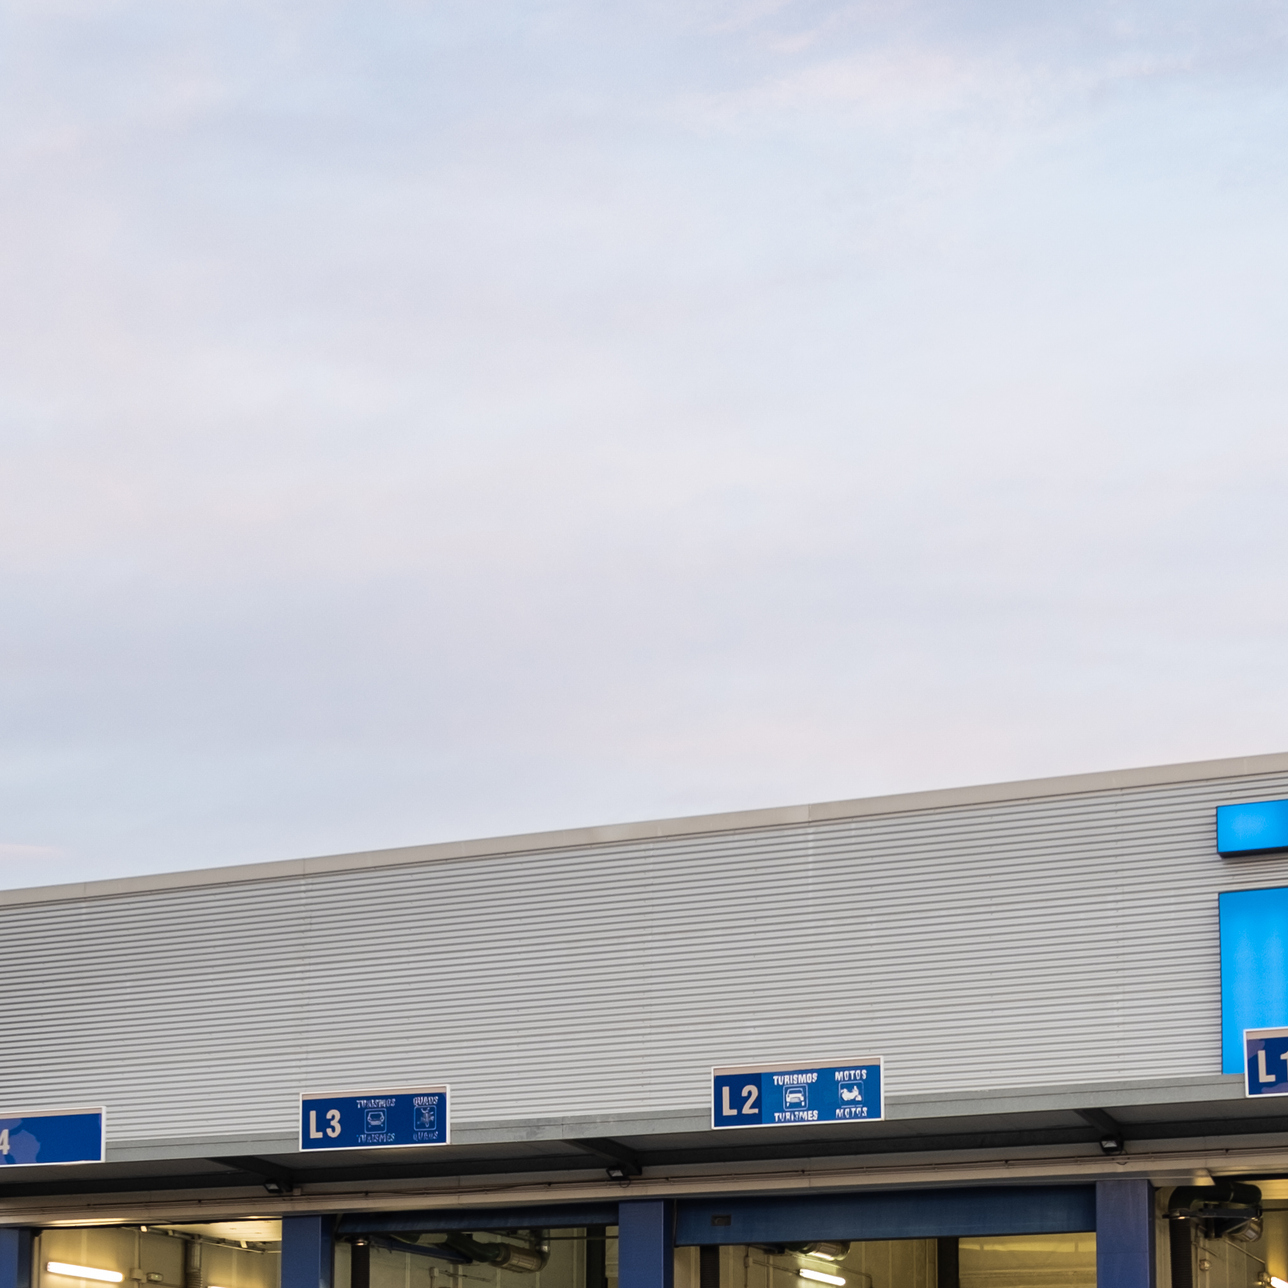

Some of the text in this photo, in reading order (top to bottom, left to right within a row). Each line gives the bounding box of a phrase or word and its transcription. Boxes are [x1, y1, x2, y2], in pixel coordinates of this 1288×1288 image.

[773, 1073, 818, 1085] TURISMOS
[835, 1069, 867, 1081] MOTOS
[356, 1098, 396, 1108] TURISMOS
[413, 1096, 439, 1107] QUADS
[722, 1084, 759, 1116] L2
[774, 1110, 818, 1122] TURISMES
[836, 1107, 868, 1118] MOTOS
[309, 1109, 341, 1139] L3
